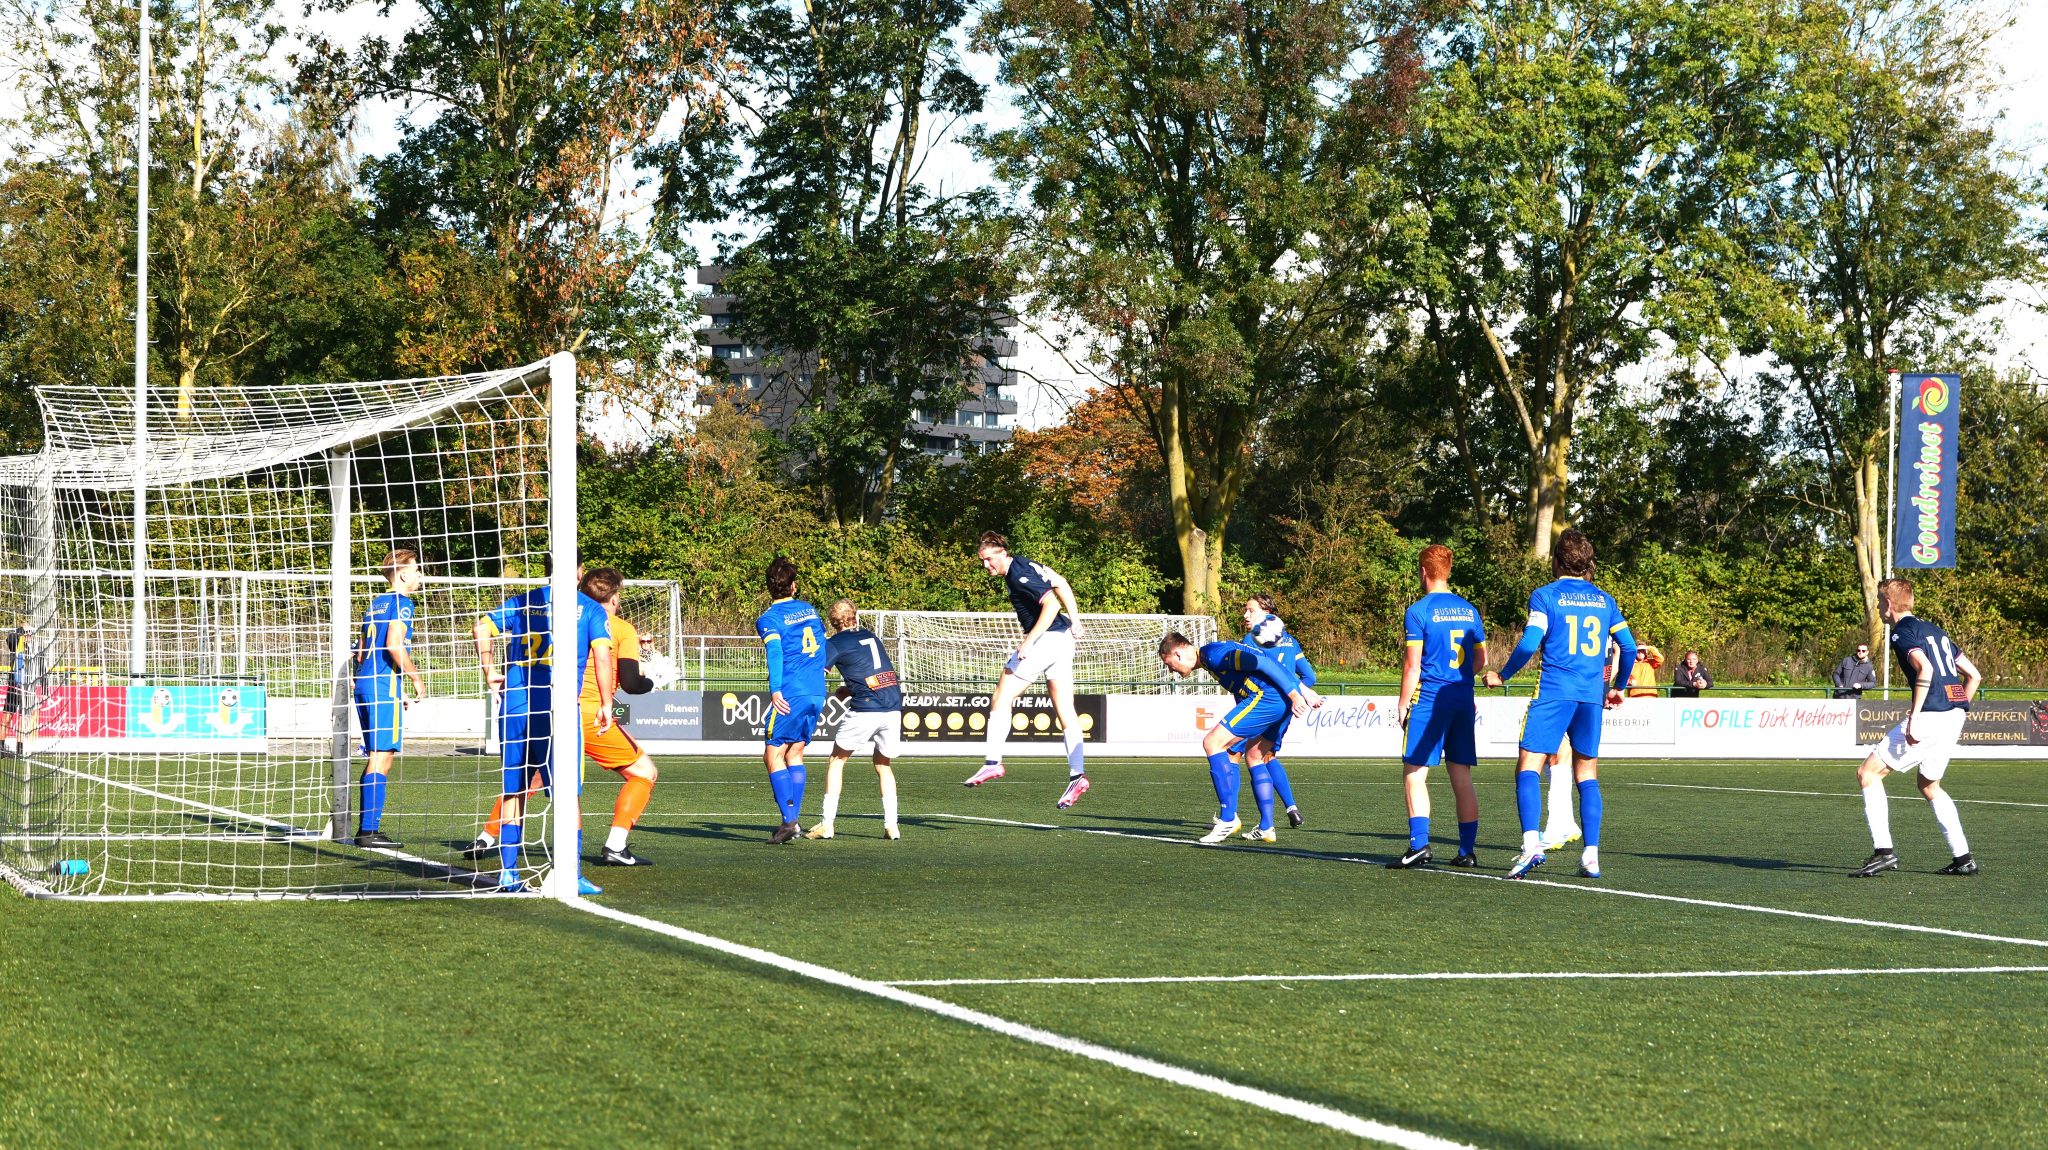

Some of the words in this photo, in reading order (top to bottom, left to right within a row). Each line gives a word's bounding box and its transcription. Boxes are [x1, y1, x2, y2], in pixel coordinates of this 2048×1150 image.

[1911, 421, 1944, 565] Goudreinet
[1561, 593, 1601, 602] BUSINESS
[1434, 607, 1470, 616] BUSINESS
[801, 626, 820, 657] 4
[1565, 615, 1601, 657] 13
[858, 637, 882, 670] 7
[1449, 629, 1465, 669] 5
[664, 704, 699, 713] Rhenen
[1012, 696, 1034, 708] THE
[636, 717, 699, 727] www.jeceve.nl
[1679, 709, 1754, 728] PROFILE
[1758, 710, 1788, 729] Dirk
[1793, 704, 1853, 729] Methorst
[1859, 709, 1902, 721] QUINT
